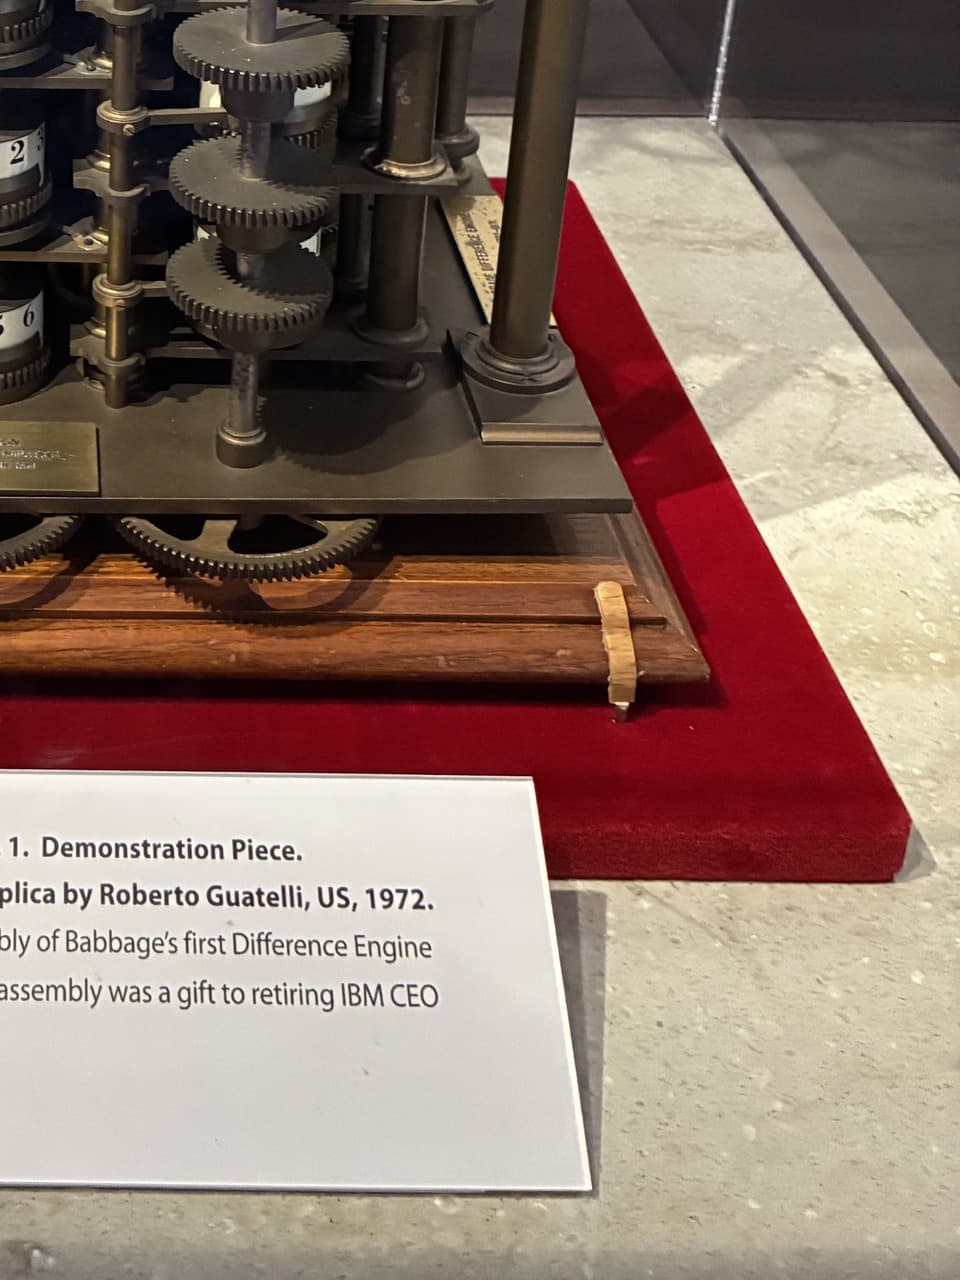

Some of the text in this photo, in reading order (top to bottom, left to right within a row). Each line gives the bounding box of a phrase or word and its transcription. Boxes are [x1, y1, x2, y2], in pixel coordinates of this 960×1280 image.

[10, 139, 26, 165] 2
[23, 304, 35, 328] 6
[8, 835, 30, 858] 1.
[41, 835, 225, 860] Demonstration
[231, 838, 303, 862] Piece.
[63, 880, 94, 912] by
[99, 882, 200, 908] Roberto
[205, 884, 311, 912] Guatelli,
[317, 885, 358, 913] US,
[364, 887, 434, 911] 1972.
[36, 928, 61, 953] of
[182, 930, 228, 956] first
[232, 931, 348, 958] Difference
[353, 934, 433, 965] Engine
[107, 984, 153, 1004] was
[158, 985, 171, 1004] a
[177, 978, 217, 1011] gift
[220, 983, 246, 1006] to
[251, 981, 335, 1014] retiring
[340, 982, 385, 1008] IBM
[389, 983, 440, 1009] CEO
